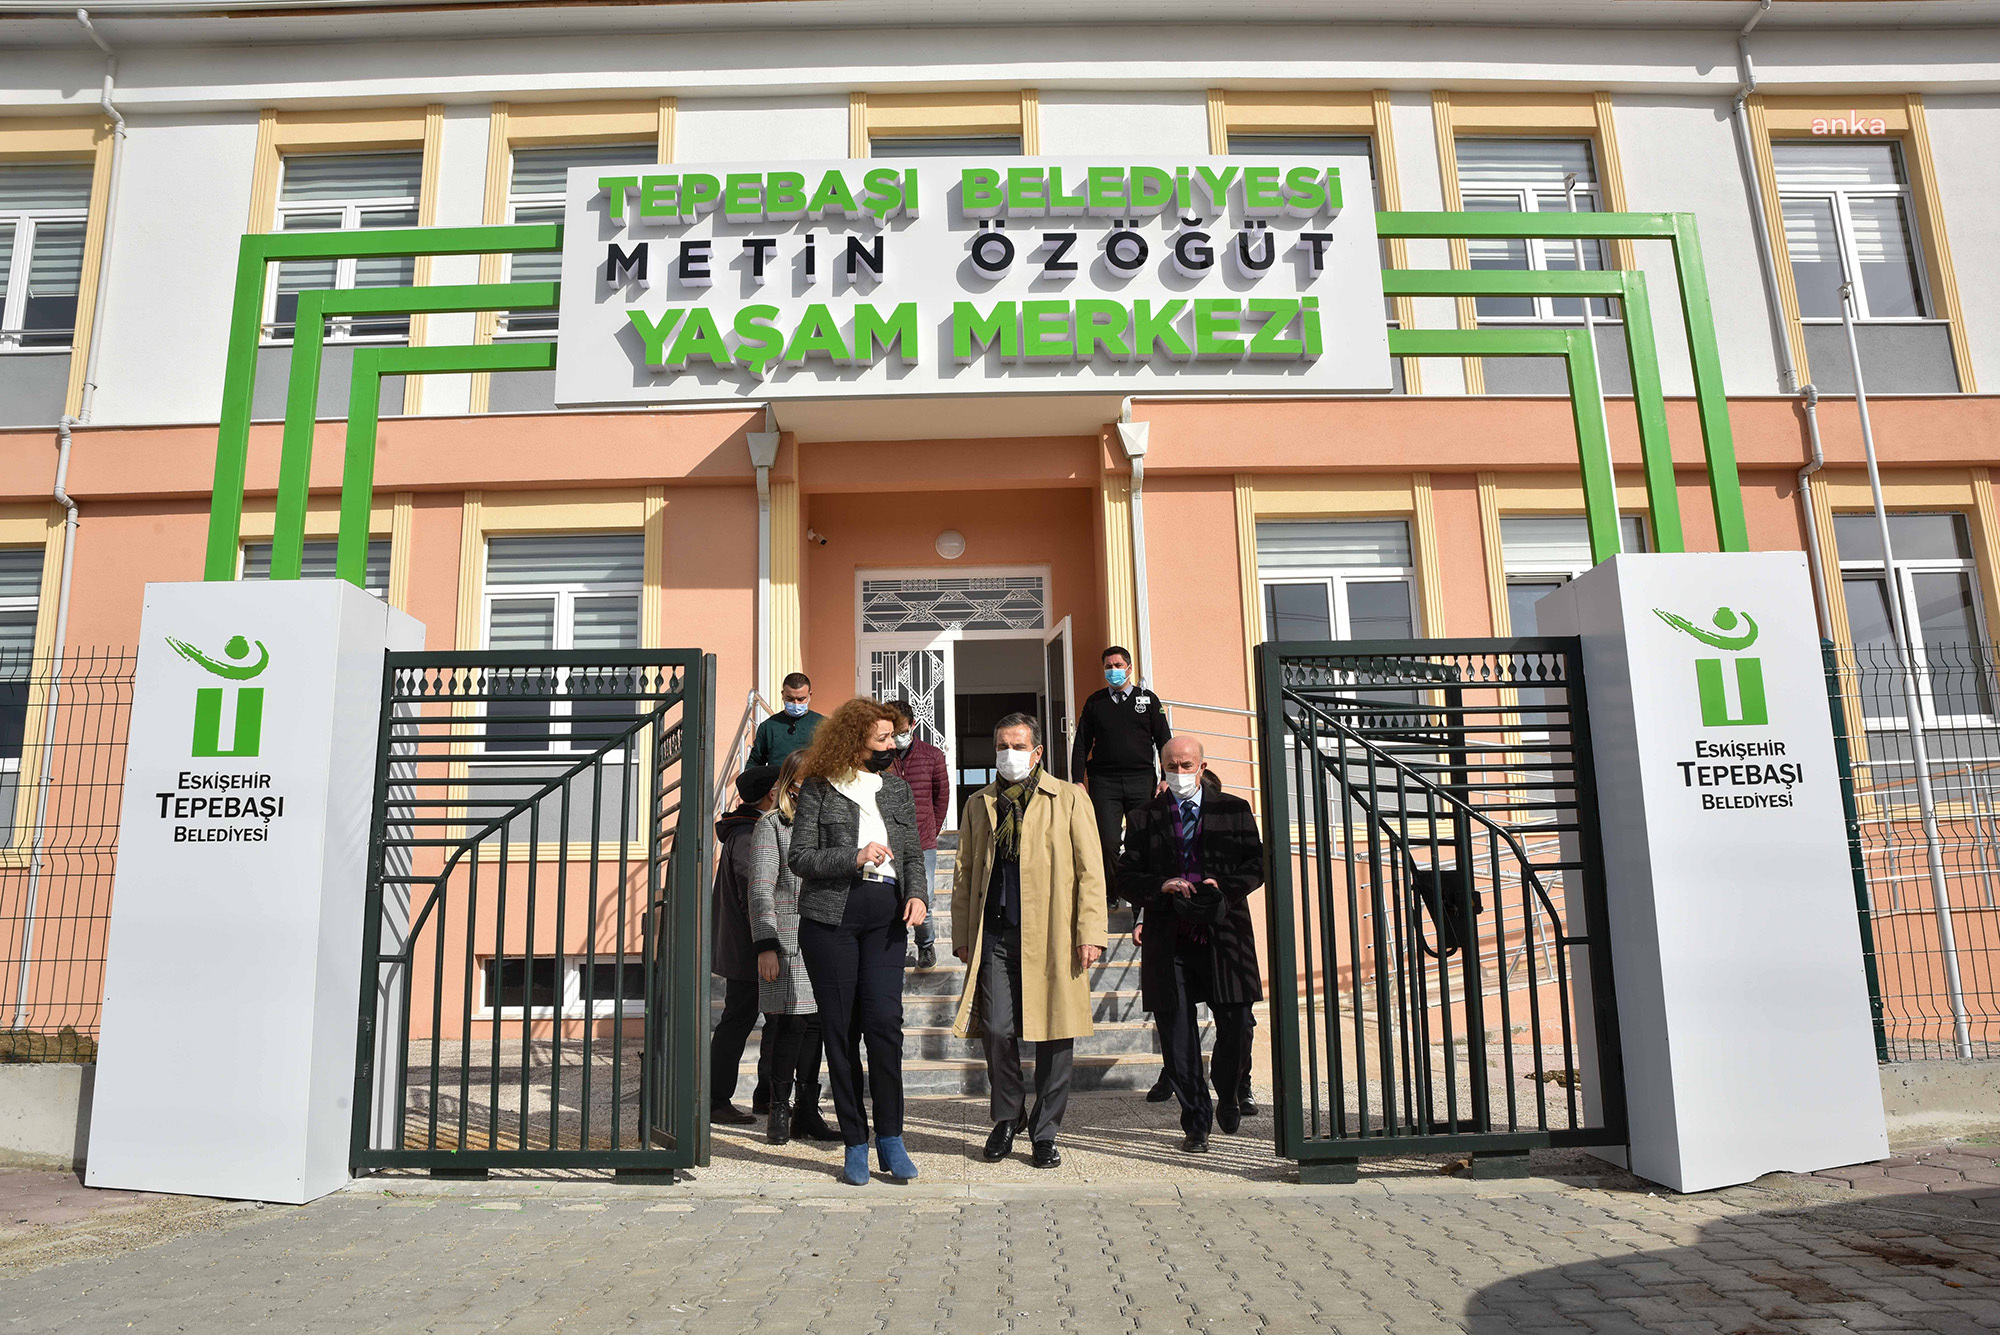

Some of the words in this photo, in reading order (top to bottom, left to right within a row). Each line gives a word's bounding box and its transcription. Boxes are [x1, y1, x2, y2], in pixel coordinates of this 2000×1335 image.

[598, 167, 920, 222] TEPEBAŞI
[961, 165, 1344, 211] BELEDİYESİ
[606, 234, 884, 282] METİN
[971, 217, 1334, 272] ÖZÖĞÜT
[625, 302, 919, 374] YAŞAM
[953, 296, 1324, 358] MERKEZİ
[1695, 739, 1786, 761] ESKİŞEHİR
[177, 771, 272, 793] ESKİŞEHİR
[1676, 761, 1804, 790] TEPEBAŞI
[155, 792, 285, 824] TEPEBAŞI
[1702, 791, 1794, 811] BELEDİYESİ
[173, 825, 269, 843] BELEDİYESİ
